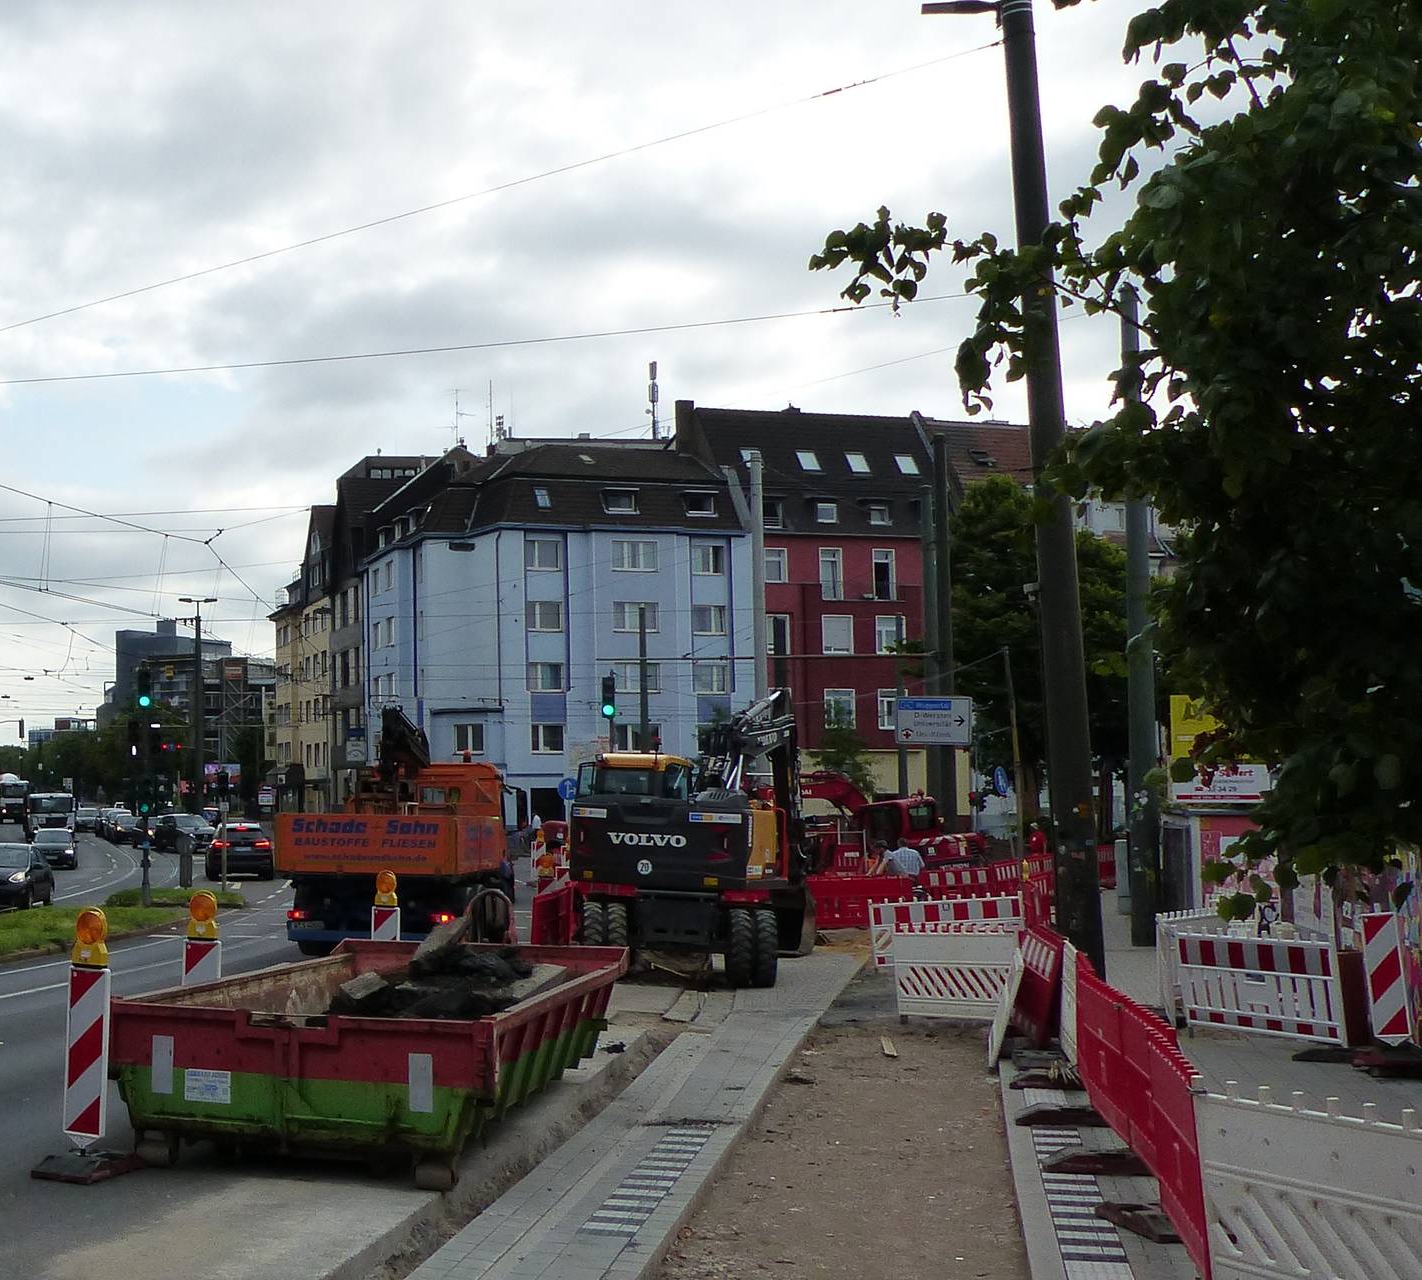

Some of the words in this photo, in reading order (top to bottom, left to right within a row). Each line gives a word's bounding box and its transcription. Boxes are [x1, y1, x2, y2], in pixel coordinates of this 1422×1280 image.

[292, 817, 367, 833] Schade
[386, 819, 439, 835] Sohn
[294, 837, 369, 847] BAUSTOFFE
[382, 838, 436, 849] FLIESEN
[607, 832, 688, 848] VOLVO
[639, 862, 649, 872] 20
